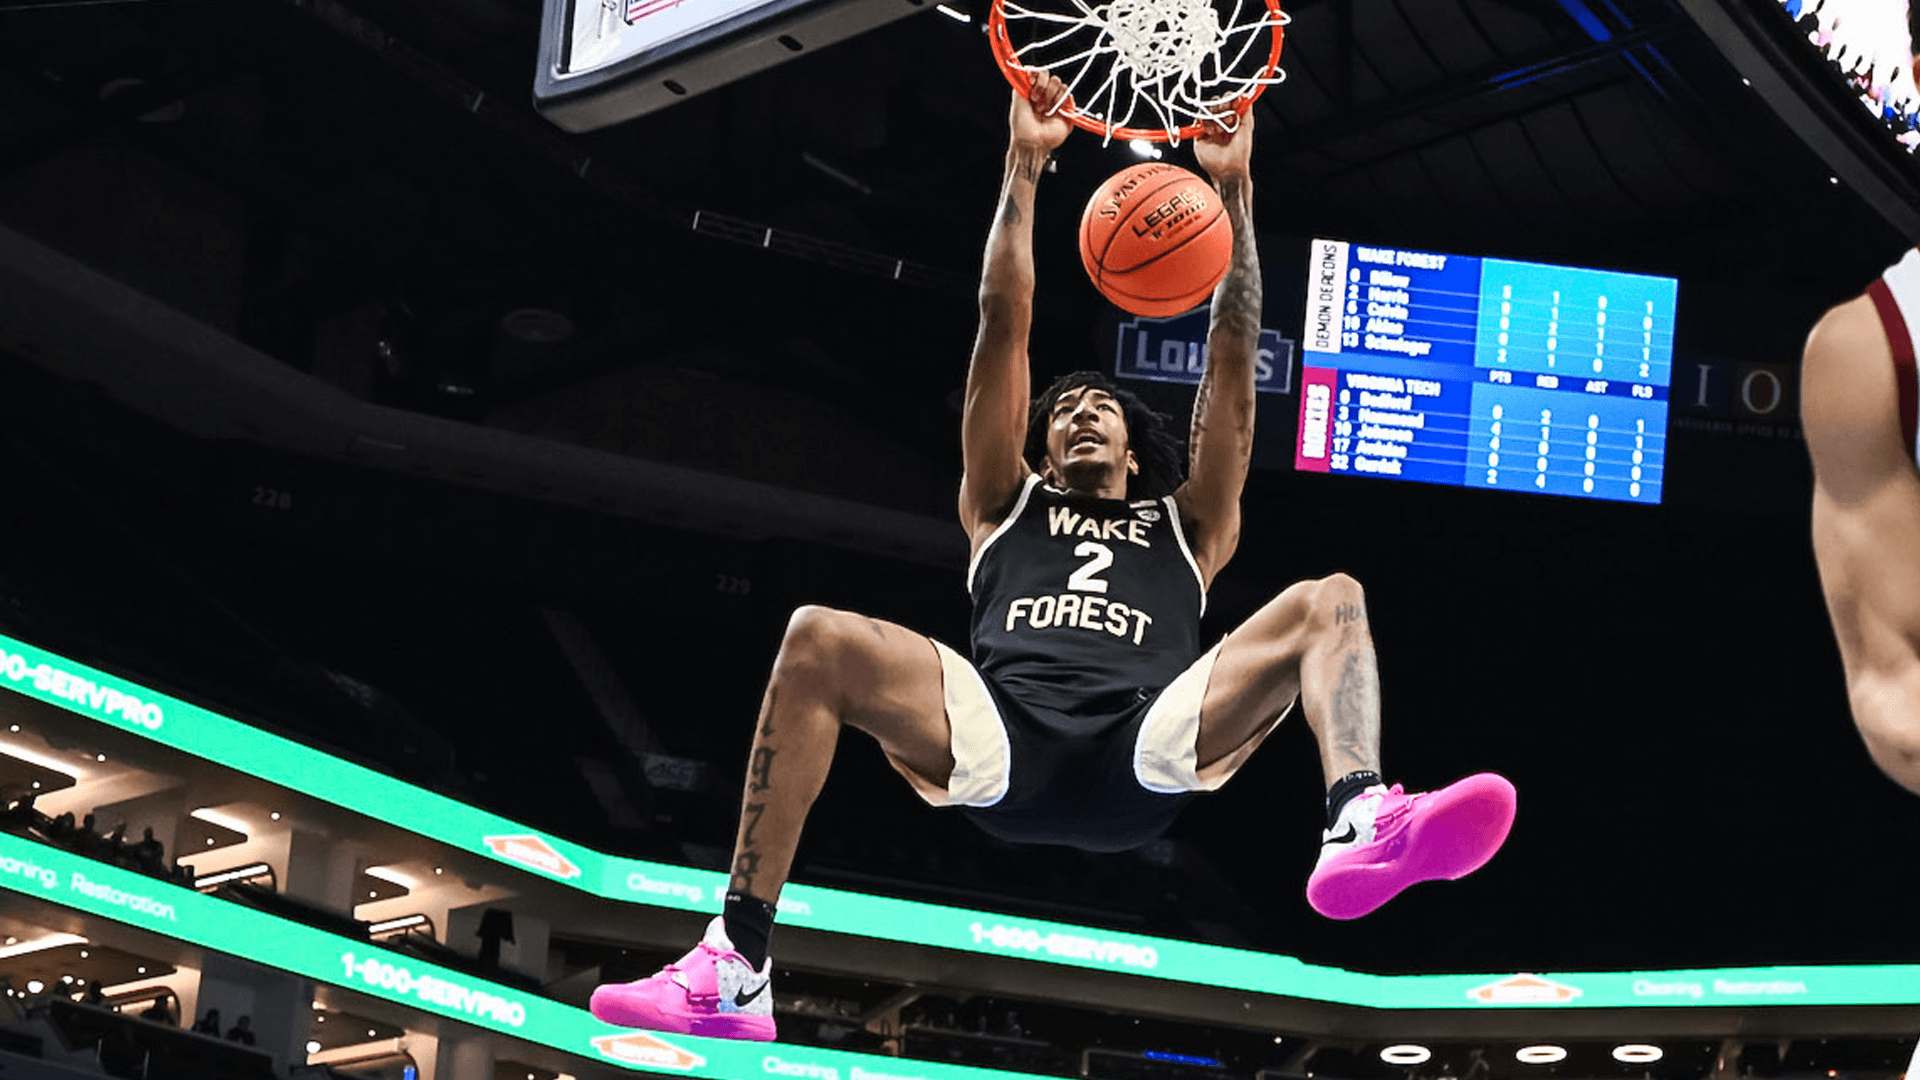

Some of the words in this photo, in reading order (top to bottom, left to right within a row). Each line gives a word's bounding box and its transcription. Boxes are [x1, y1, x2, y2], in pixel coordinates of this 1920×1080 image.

[1318, 244, 1338, 302] DEACONS
[1357, 247, 1396, 265] WAKE
[1396, 251, 1447, 270] FOREST
[1315, 304, 1332, 349] DEMON
[1405, 379, 1441, 397] TECH
[1048, 507, 1153, 549] WAKE
[1066, 540, 1115, 594] 2
[1005, 594, 1153, 646] FOREST
[0, 857, 59, 889] aning.
[71, 873, 176, 922] Restoration.
[969, 922, 1158, 969] 1-800-SERVPRO
[341, 952, 526, 1027] 1-800-SERVPRO
